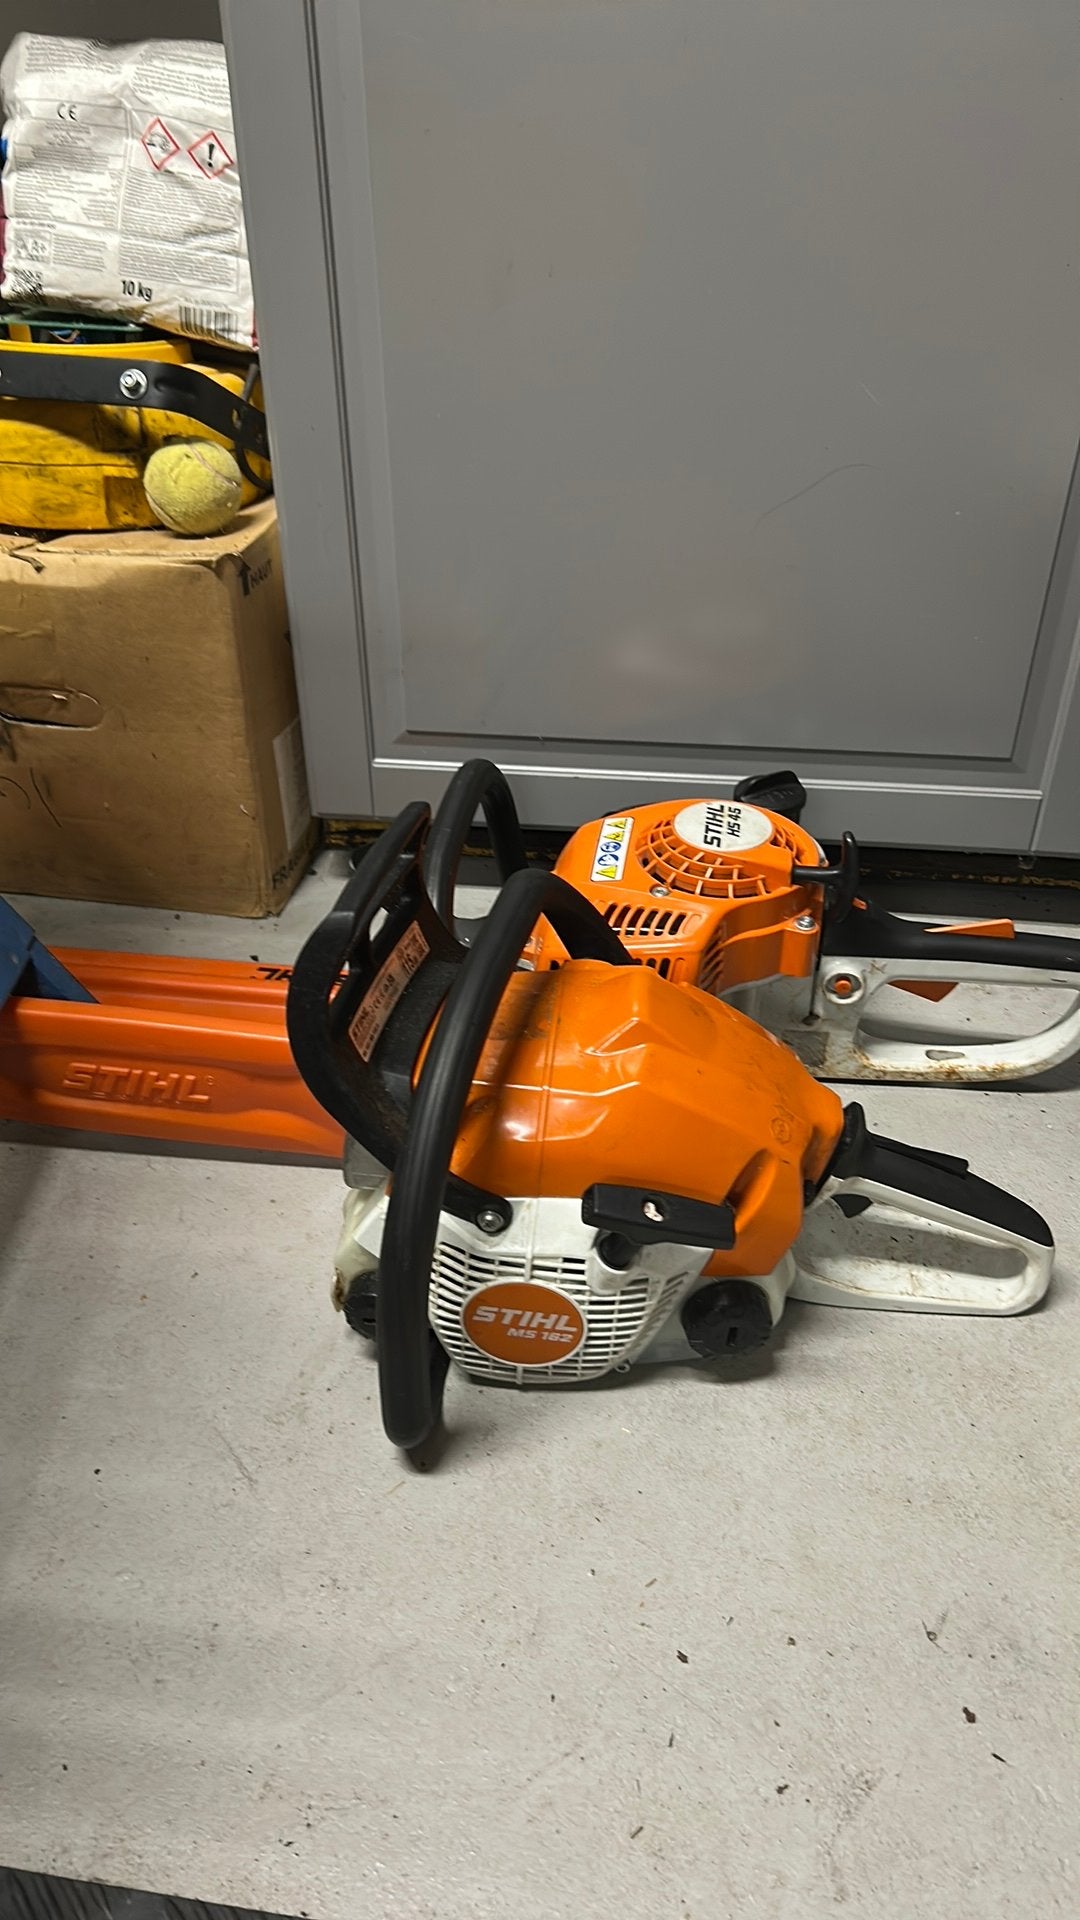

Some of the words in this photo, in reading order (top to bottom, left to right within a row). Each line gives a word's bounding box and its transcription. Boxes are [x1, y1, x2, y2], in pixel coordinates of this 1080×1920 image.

[121, 280, 135, 296] 10
[137, 282, 153, 302] kg
[727, 807, 741, 822] 45
[703, 805, 725, 848] STIHL
[727, 822, 741, 838] HS
[62, 1062, 211, 1104] STIHL
[472, 1306, 578, 1332] STIHL
[506, 1328, 537, 1340] MS
